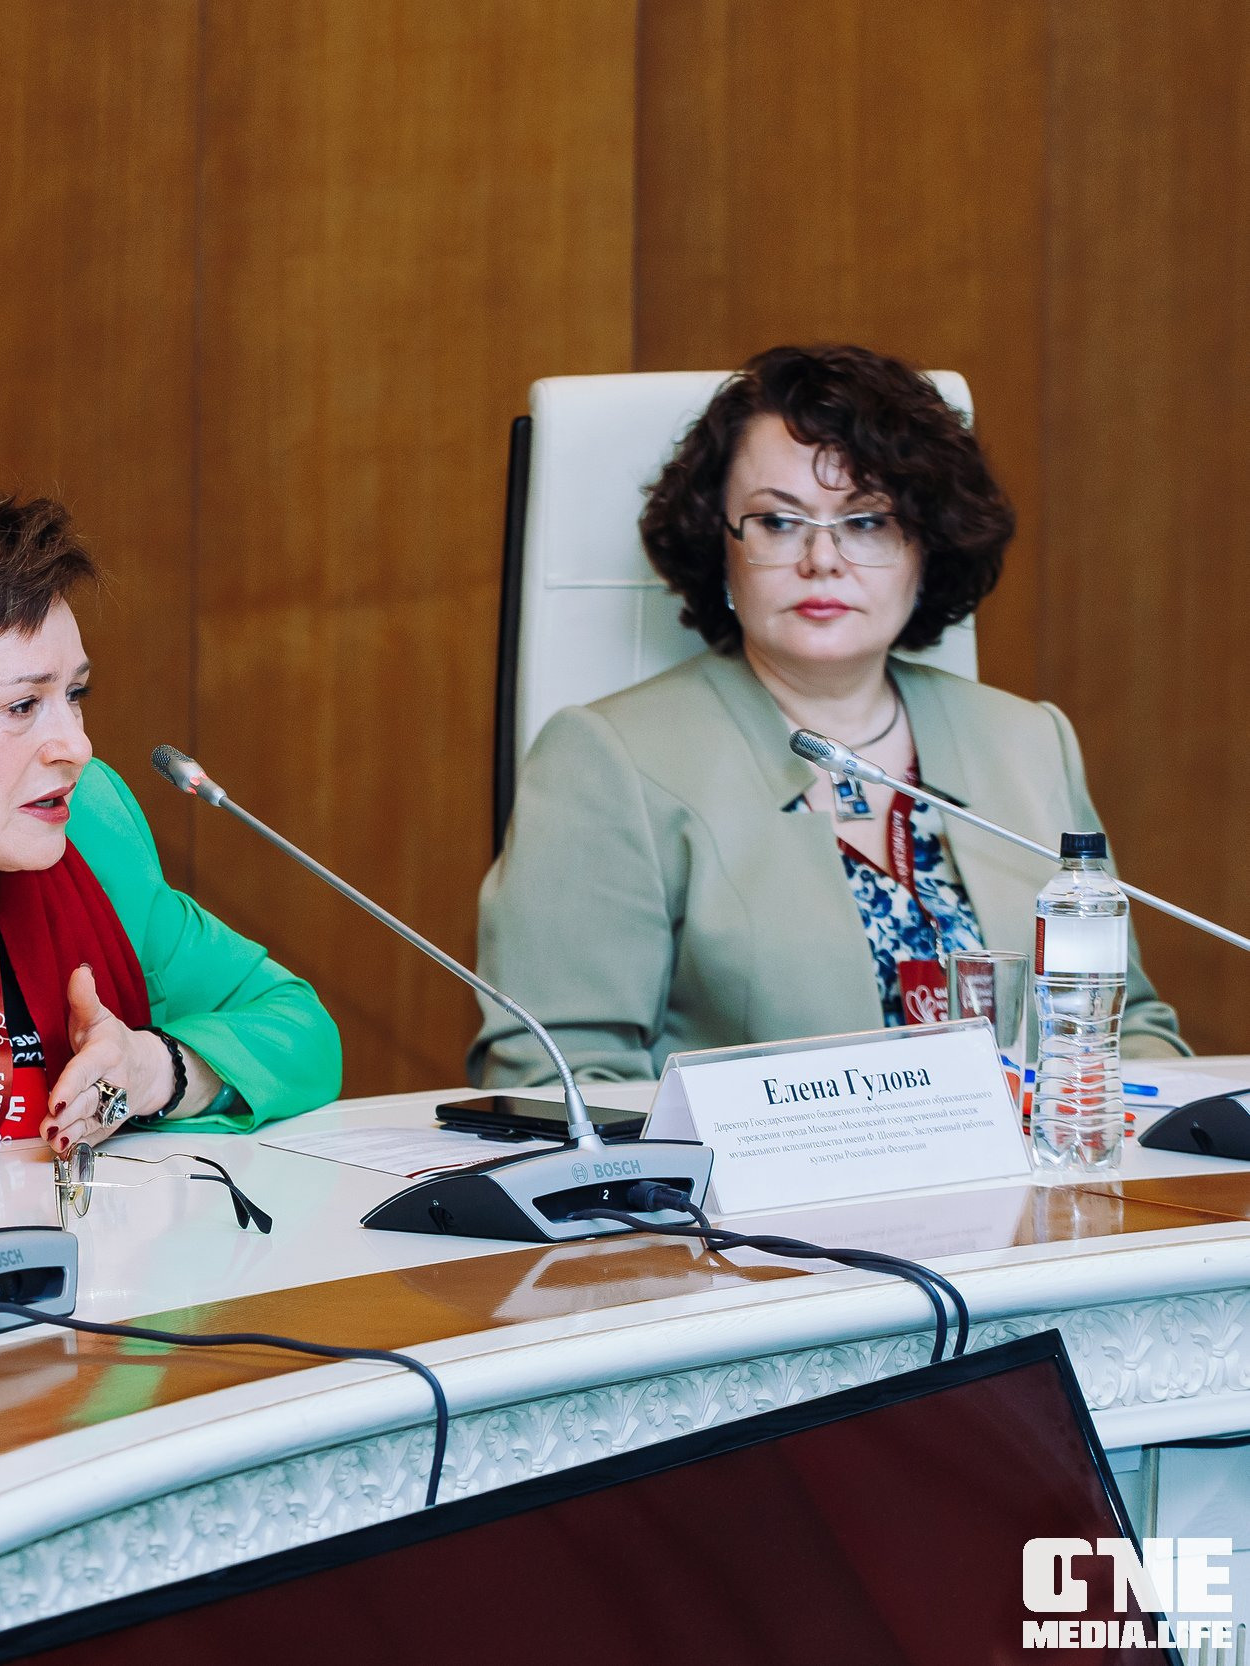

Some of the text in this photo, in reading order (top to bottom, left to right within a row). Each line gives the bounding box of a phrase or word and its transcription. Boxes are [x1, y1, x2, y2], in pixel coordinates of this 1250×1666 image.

[762, 1068, 931, 1105] Елена Гудова
[714, 1121, 749, 1133] Директор
[750, 1112, 816, 1128] Государственного
[782, 1127, 808, 1141] города
[808, 1124, 838, 1135] Москвы
[593, 1159, 642, 1179] BOSCH
[602, 1189, 609, 1200] 2
